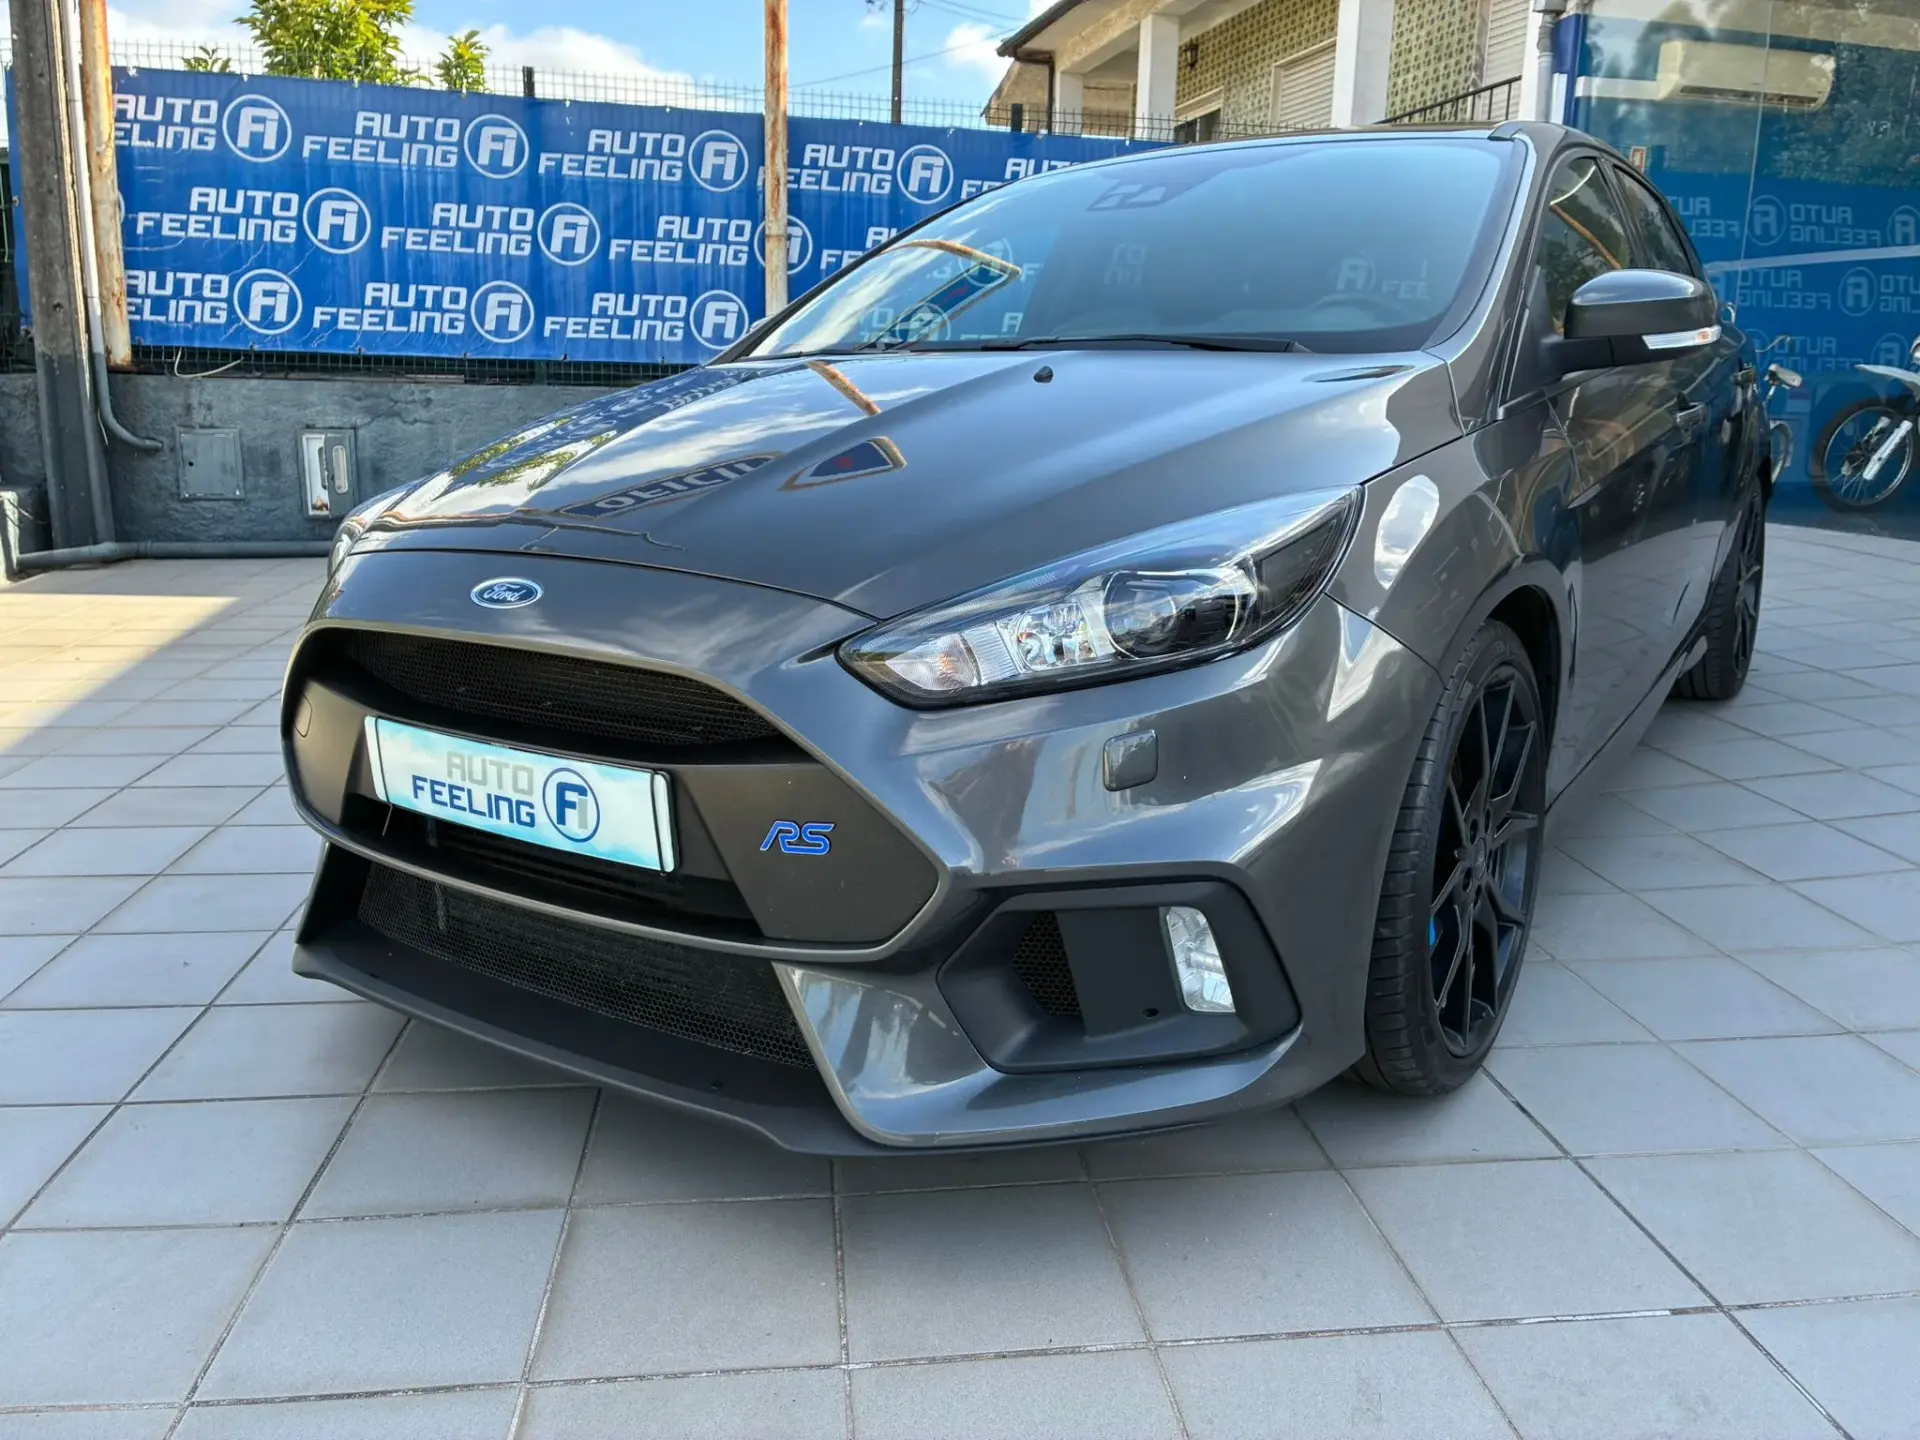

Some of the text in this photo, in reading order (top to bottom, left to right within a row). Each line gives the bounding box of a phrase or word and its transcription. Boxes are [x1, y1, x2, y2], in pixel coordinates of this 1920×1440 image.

[113, 94, 219, 124] AUTO
[114, 122, 217, 151] ELING
[355, 111, 460, 143] AUTO
[302, 135, 458, 168] FEELING
[588, 129, 686, 157] AUTO
[803, 143, 896, 171] AUTO
[538, 152, 683, 182] FEELING
[190, 187, 299, 217] AUTO
[432, 202, 534, 231] AUTO
[136, 211, 297, 243] FEELING
[381, 226, 532, 256] FEELING
[656, 215, 751, 242] AUTO
[608, 238, 748, 266] FEELING
[125, 269, 229, 298] AUTO
[365, 282, 467, 310] AUTO
[127, 297, 228, 324] ELING
[592, 292, 688, 318] AUTO
[313, 306, 465, 335] FEELING
[543, 316, 684, 341] FEELING
[483, 583, 526, 601] Ford
[447, 750, 535, 796] AUTO
[411, 774, 536, 828] FEELING
[760, 820, 835, 855] RS
